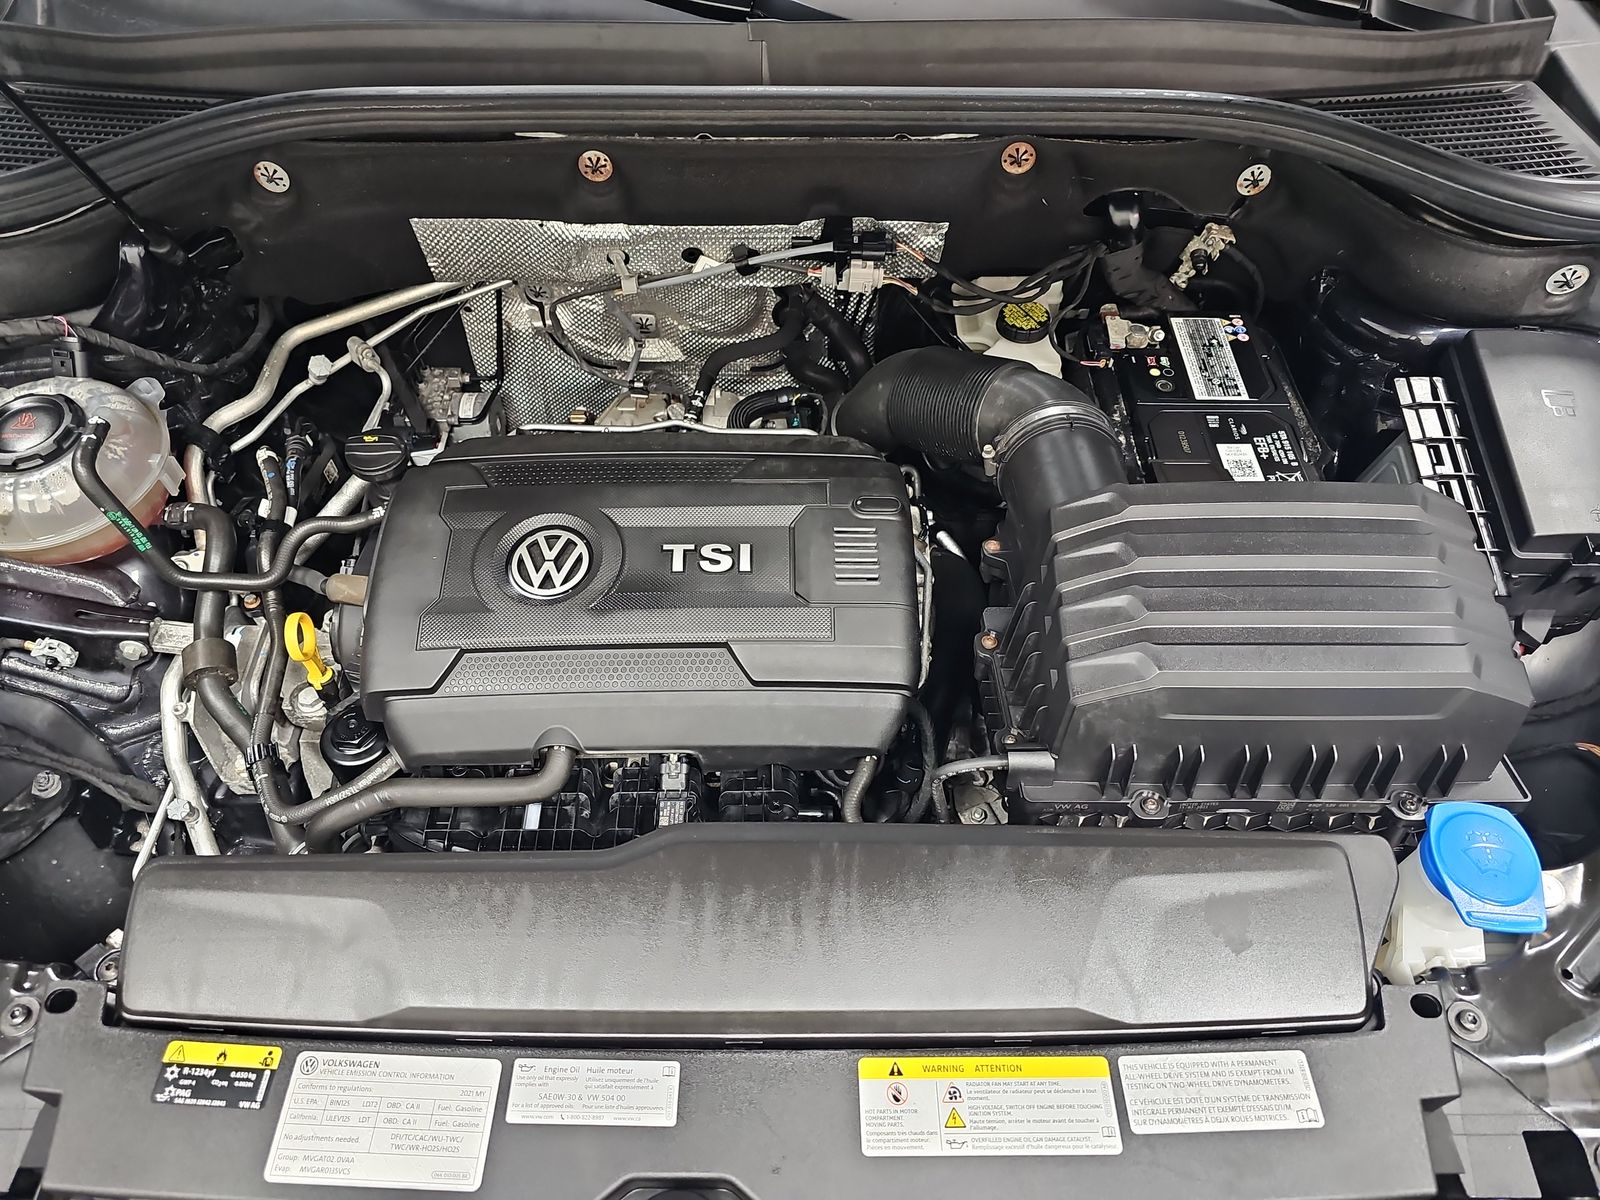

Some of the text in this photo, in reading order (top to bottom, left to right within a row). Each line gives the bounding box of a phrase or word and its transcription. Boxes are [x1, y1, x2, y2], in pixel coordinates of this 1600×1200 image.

[1228, 418, 1240, 440] CLARIOS
[1253, 437, 1269, 460] EFB+
[662, 543, 751, 573] TSI
[322, 1059, 380, 1068] VOLKSWAGEN
[922, 1064, 1022, 1072] WARNING ATTENTION
[1176, 1062, 1209, 1070] EQUIPPED
[544, 1066, 568, 1075] Engine
[249, 1072, 257, 1081] kg
[409, 1072, 455, 1080] INFORMATION
[1234, 1078, 1292, 1086] DYNAMOMETERS.
[176, 1089, 192, 1097] PAG
[1262, 1093, 1311, 1101] TRANSMISSION
[452, 1120, 480, 1128] Gasoline
[294, 1134, 334, 1143] adjustments
[302, 1154, 354, 1164] MVGAT02.0VAA
